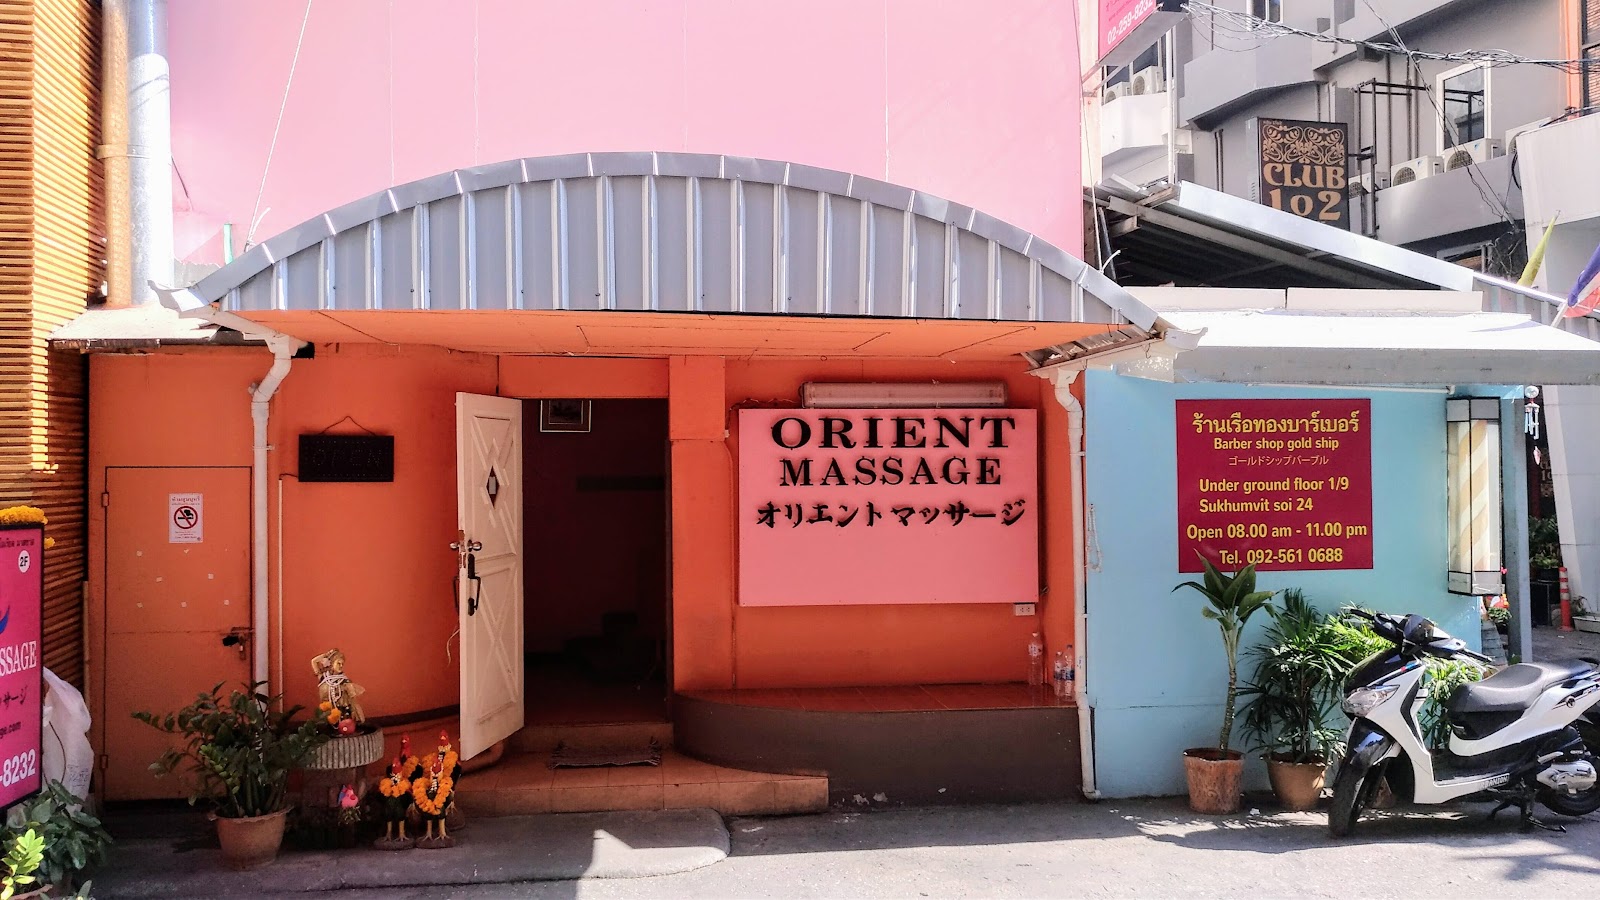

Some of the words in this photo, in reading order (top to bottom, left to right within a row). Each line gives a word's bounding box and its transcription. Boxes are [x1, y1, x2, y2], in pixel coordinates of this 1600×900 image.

[1263, 163, 1346, 189] CLUB
[1192, 410, 1360, 433] ร้านเรือทองบาร์เบอร์
[771, 417, 1015, 449] ORIENT
[1213, 437, 1252, 450] Barber
[1255, 438, 1284, 452] shop
[1287, 437, 1312, 452] gold
[1315, 437, 1339, 451] ship
[779, 456, 1002, 487] MASSAGE
[1199, 478, 1240, 493] Under
[1243, 478, 1290, 494] ground
[1293, 477, 1325, 491] floor
[1328, 476, 1350, 491] 1/9
[1199, 498, 1270, 513] Sukhumvit
[1273, 498, 1293, 512] soi
[1296, 497, 1314, 511] 24
[1186, 524, 1223, 541] Open
[1227, 523, 1268, 538] 08.00
[1271, 527, 1292, 538] am
[1306, 522, 1342, 537] 11.00
[1346, 525, 1368, 539] pm
[20, 556, 28, 567] 2F
[1219, 549, 1243, 564] Tel.
[1246, 548, 1302, 564] 092-561
[1307, 547, 1344, 563] 0688
